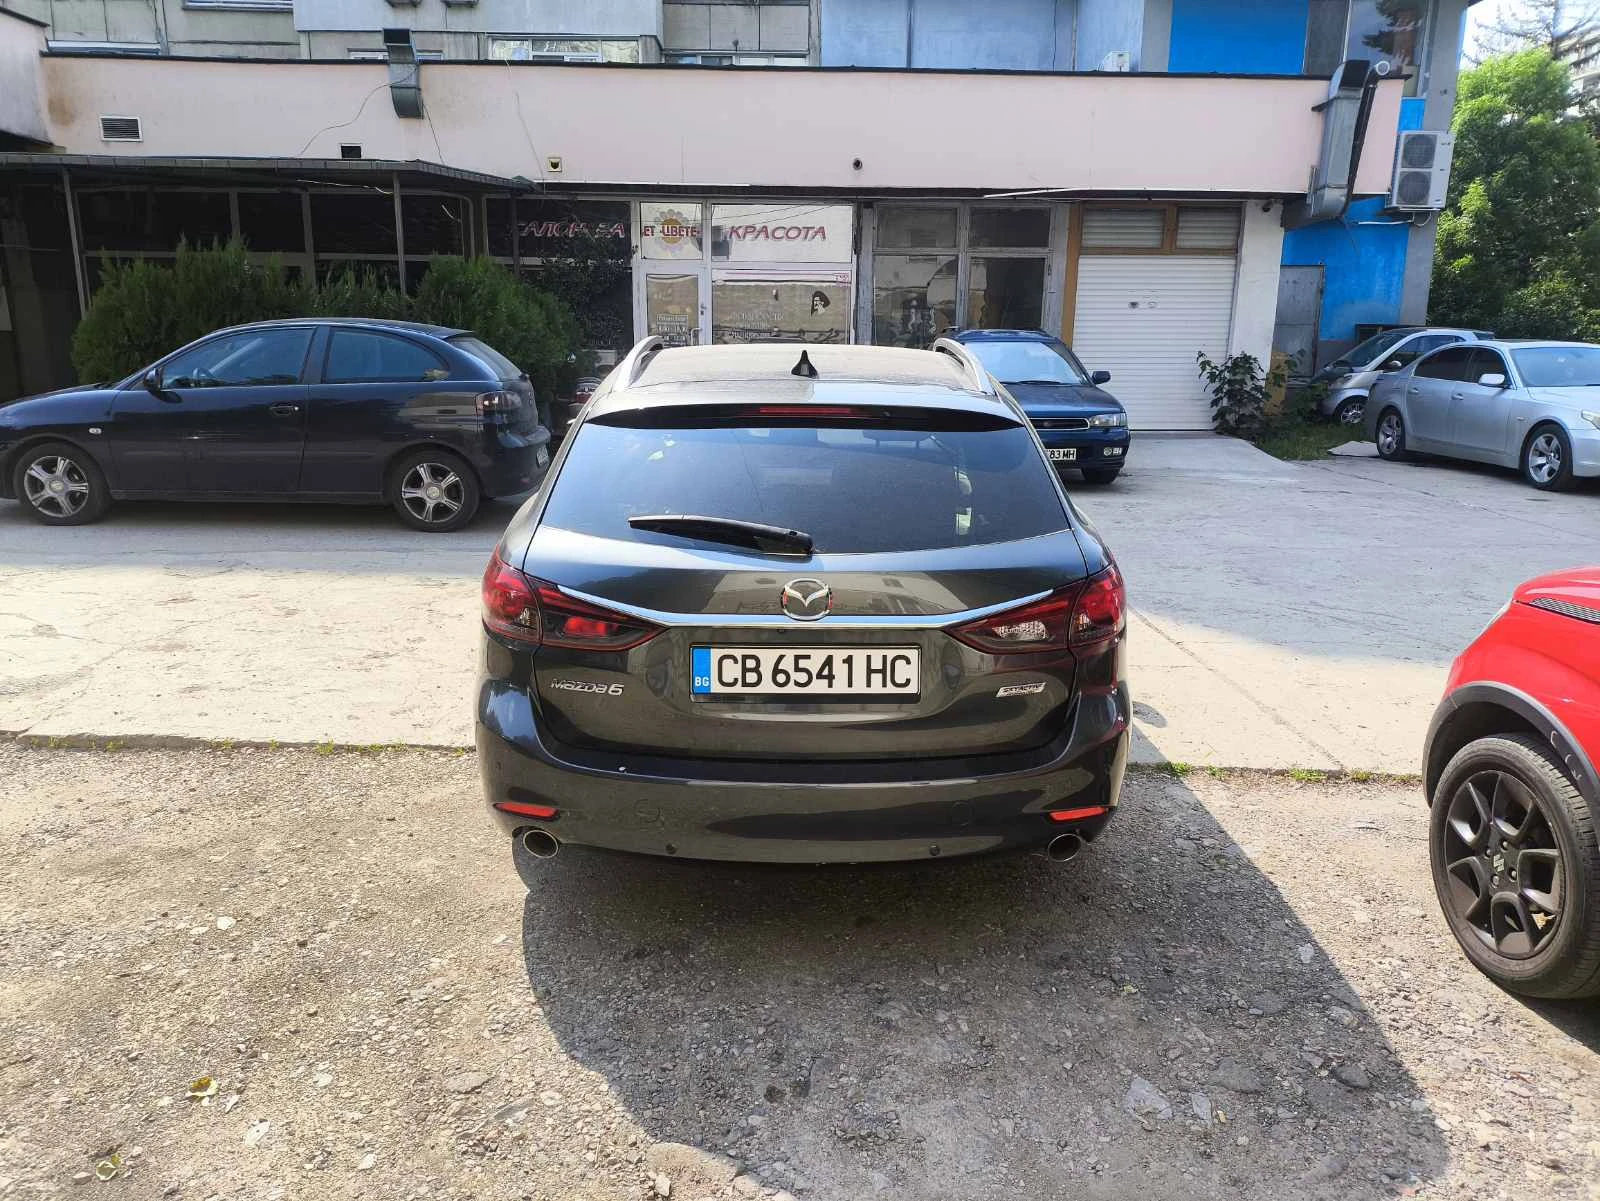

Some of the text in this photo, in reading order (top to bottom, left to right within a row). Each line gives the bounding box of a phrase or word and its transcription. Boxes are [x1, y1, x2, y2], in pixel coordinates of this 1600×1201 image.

[729, 225, 827, 240] КРАСОТА
[717, 654, 912, 688] CB 6541 HC
[694, 677, 709, 687] BG
